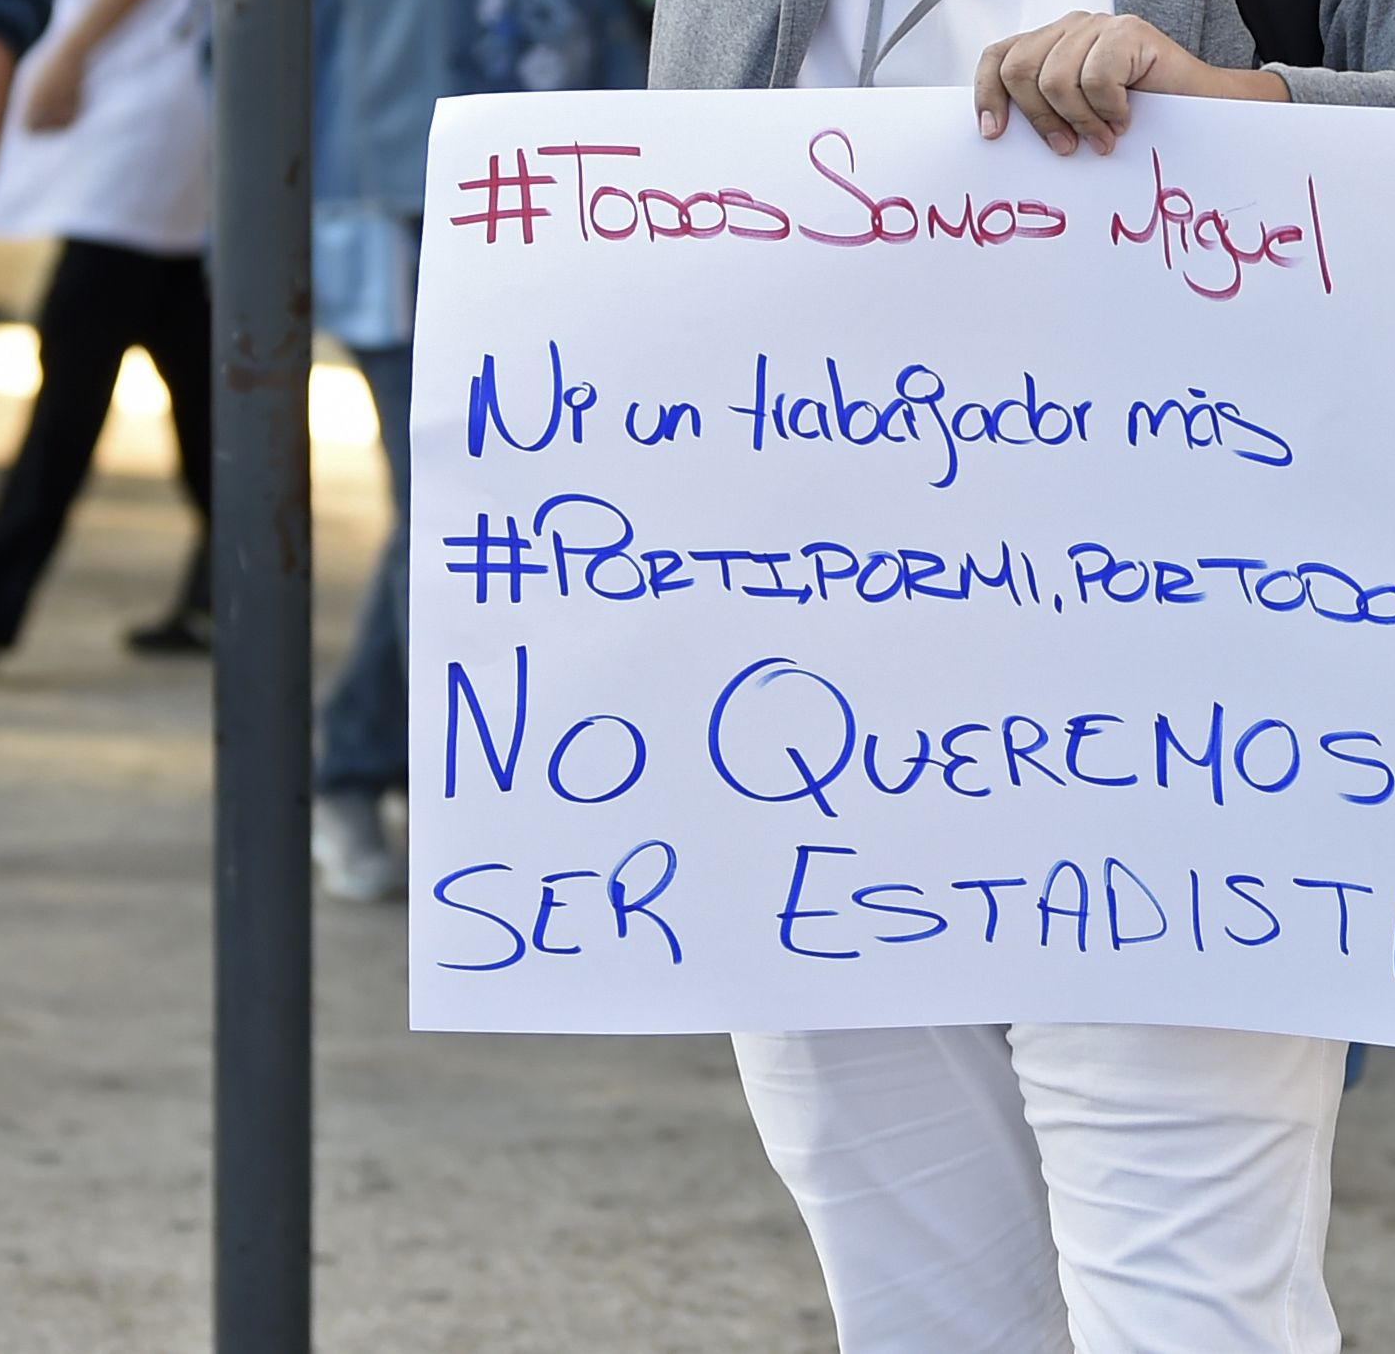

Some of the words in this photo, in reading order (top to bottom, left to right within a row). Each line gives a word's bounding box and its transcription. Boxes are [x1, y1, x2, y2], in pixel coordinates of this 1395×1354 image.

[467, 340, 598, 458] Ni
[625, 401, 702, 446] un
[728, 352, 1093, 488] trabajador
[1127, 387, 1294, 467] más
[432, 839, 683, 972] SER
